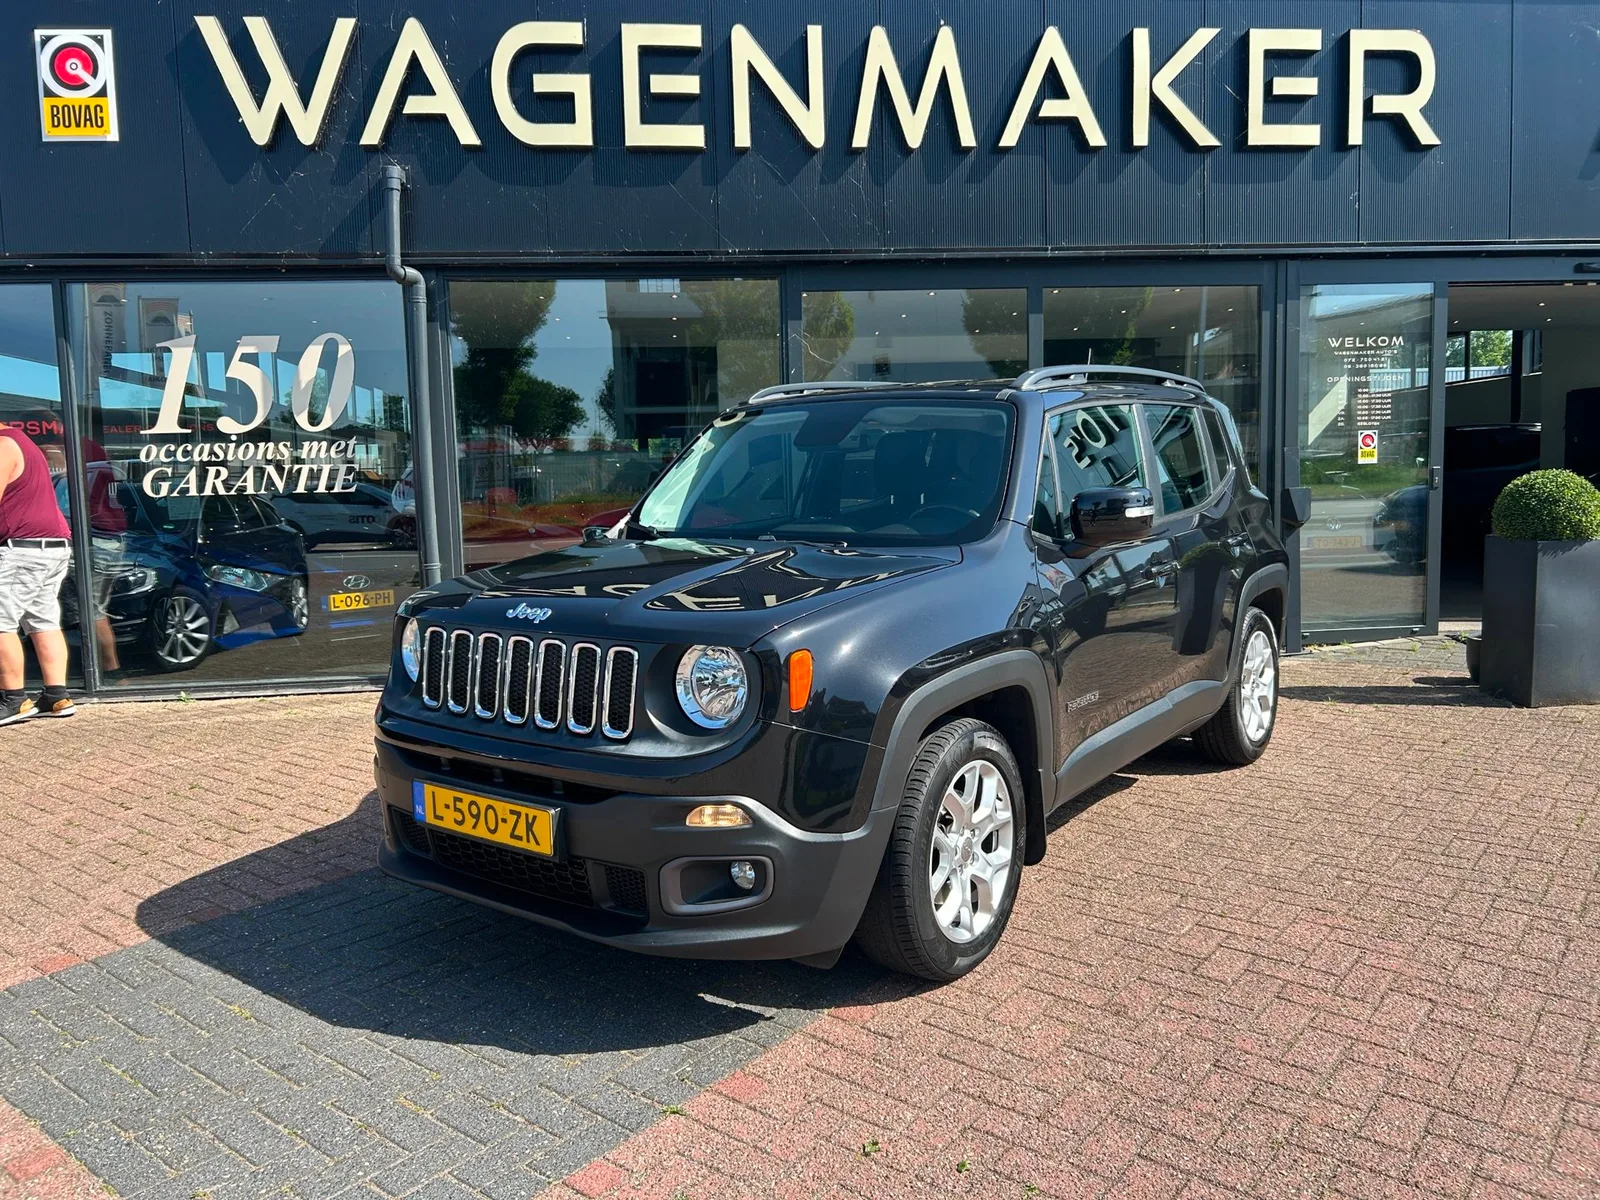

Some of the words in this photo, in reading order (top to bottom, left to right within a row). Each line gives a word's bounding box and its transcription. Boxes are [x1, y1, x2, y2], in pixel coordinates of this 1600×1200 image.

[193, 15, 1441, 149] WAGENMAKER
[50, 104, 105, 128] BOVAG
[1327, 336, 1405, 348] WELKOM
[140, 332, 355, 434] 150
[139, 434, 291, 463] occasions
[300, 436, 358, 460] met
[1360, 450, 1375, 458] BOVAG
[142, 463, 360, 498] GARANTIE
[332, 591, 391, 609] L-096-PH
[506, 602, 552, 624] Jeep
[415, 804, 425, 815] NL
[431, 790, 541, 846] L-590-ZK
